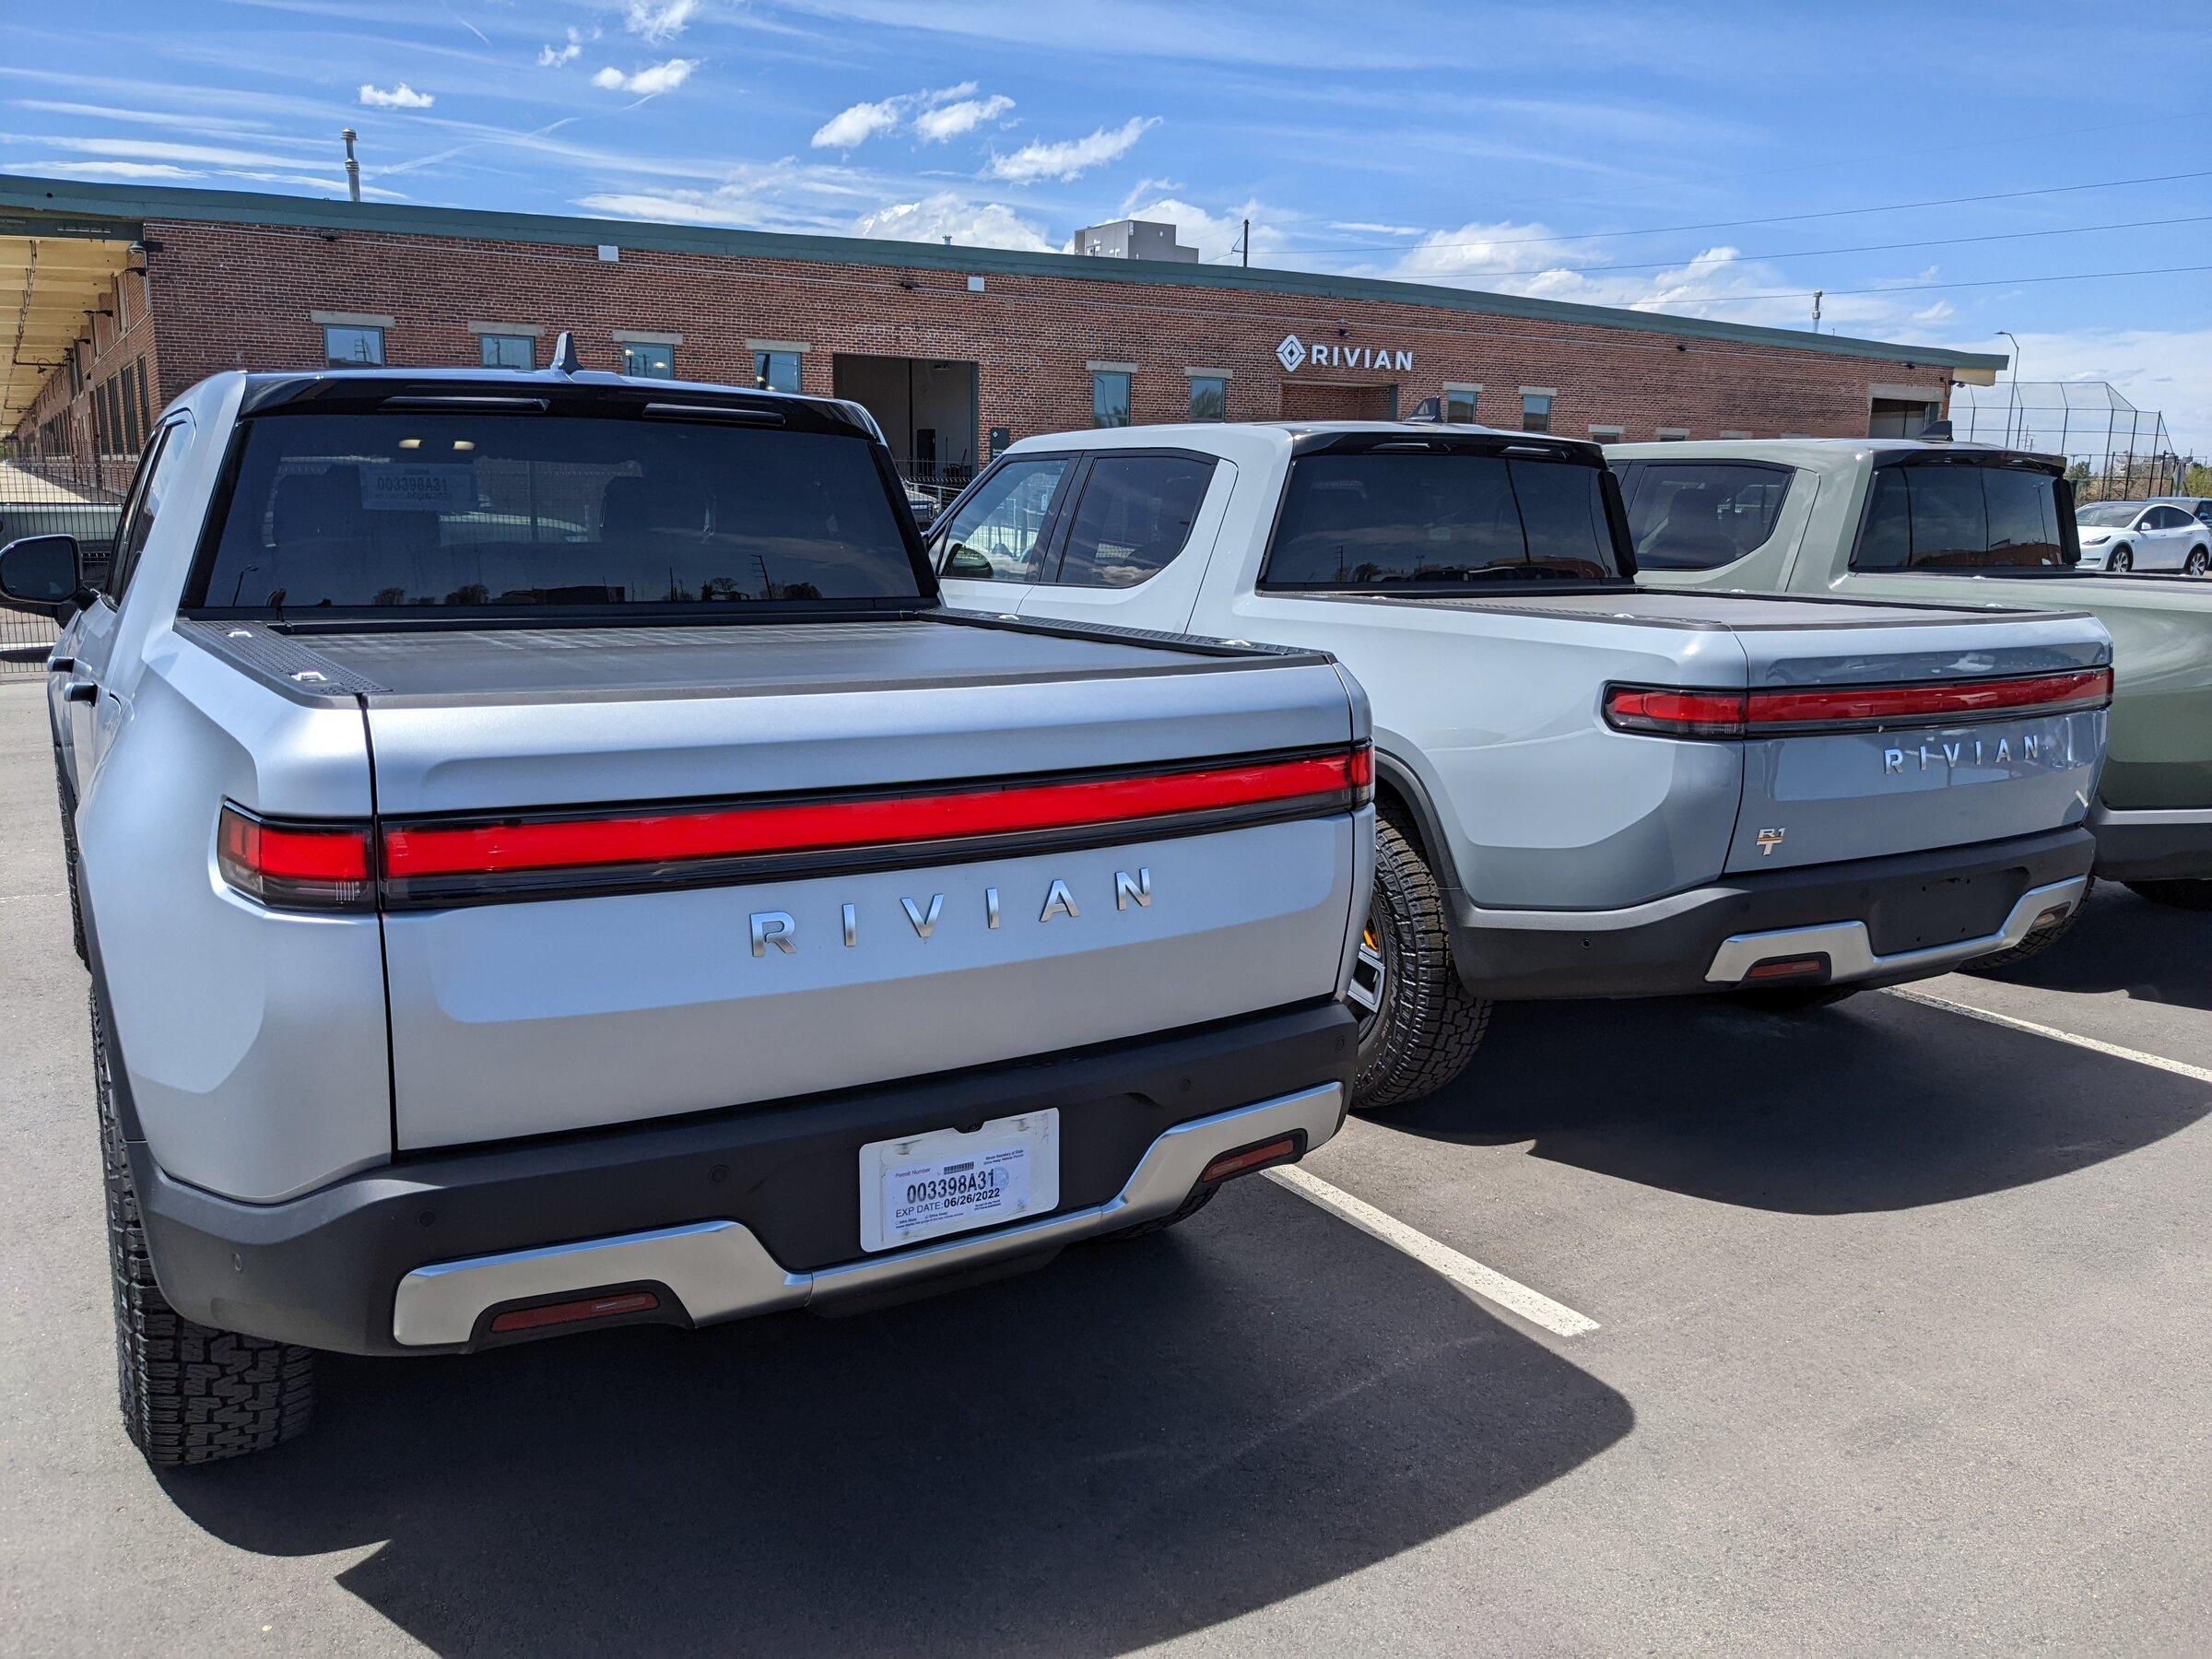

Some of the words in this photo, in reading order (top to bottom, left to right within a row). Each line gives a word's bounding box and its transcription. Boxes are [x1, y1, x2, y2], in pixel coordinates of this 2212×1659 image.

[1311, 345, 1413, 371] RIVIAN
[1883, 735, 2039, 775] RIVIAN
[749, 867, 1151, 958] RIVIAN
[895, 1206, 914, 1218] EXP
[944, 1187, 1001, 1208] 06/26/2022
[906, 1168, 994, 1205] 003398A31
